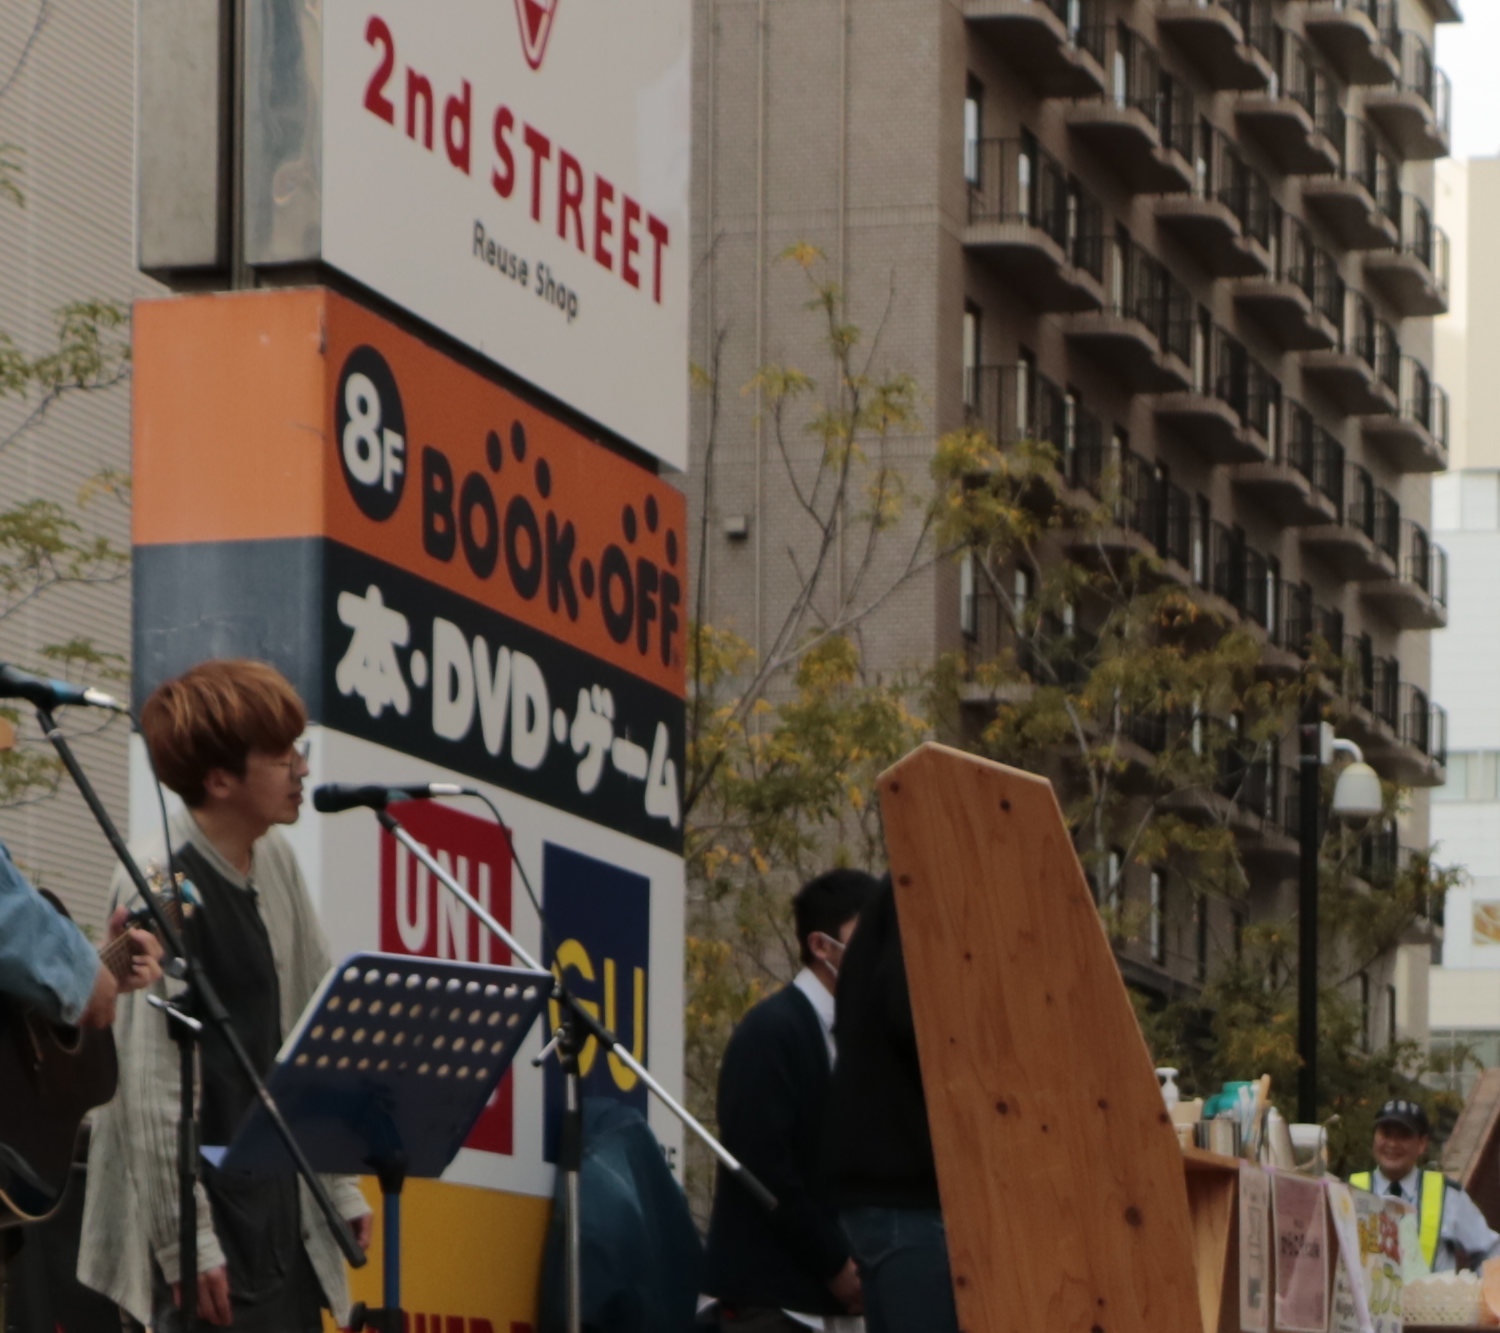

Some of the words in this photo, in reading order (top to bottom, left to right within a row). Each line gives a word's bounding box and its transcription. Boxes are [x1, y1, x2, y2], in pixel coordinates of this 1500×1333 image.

[362, 14, 472, 177] 2nd
[489, 103, 671, 306] STREET
[472, 219, 530, 288] Reuse
[534, 261, 579, 325] Shop
[342, 371, 405, 494] 8F
